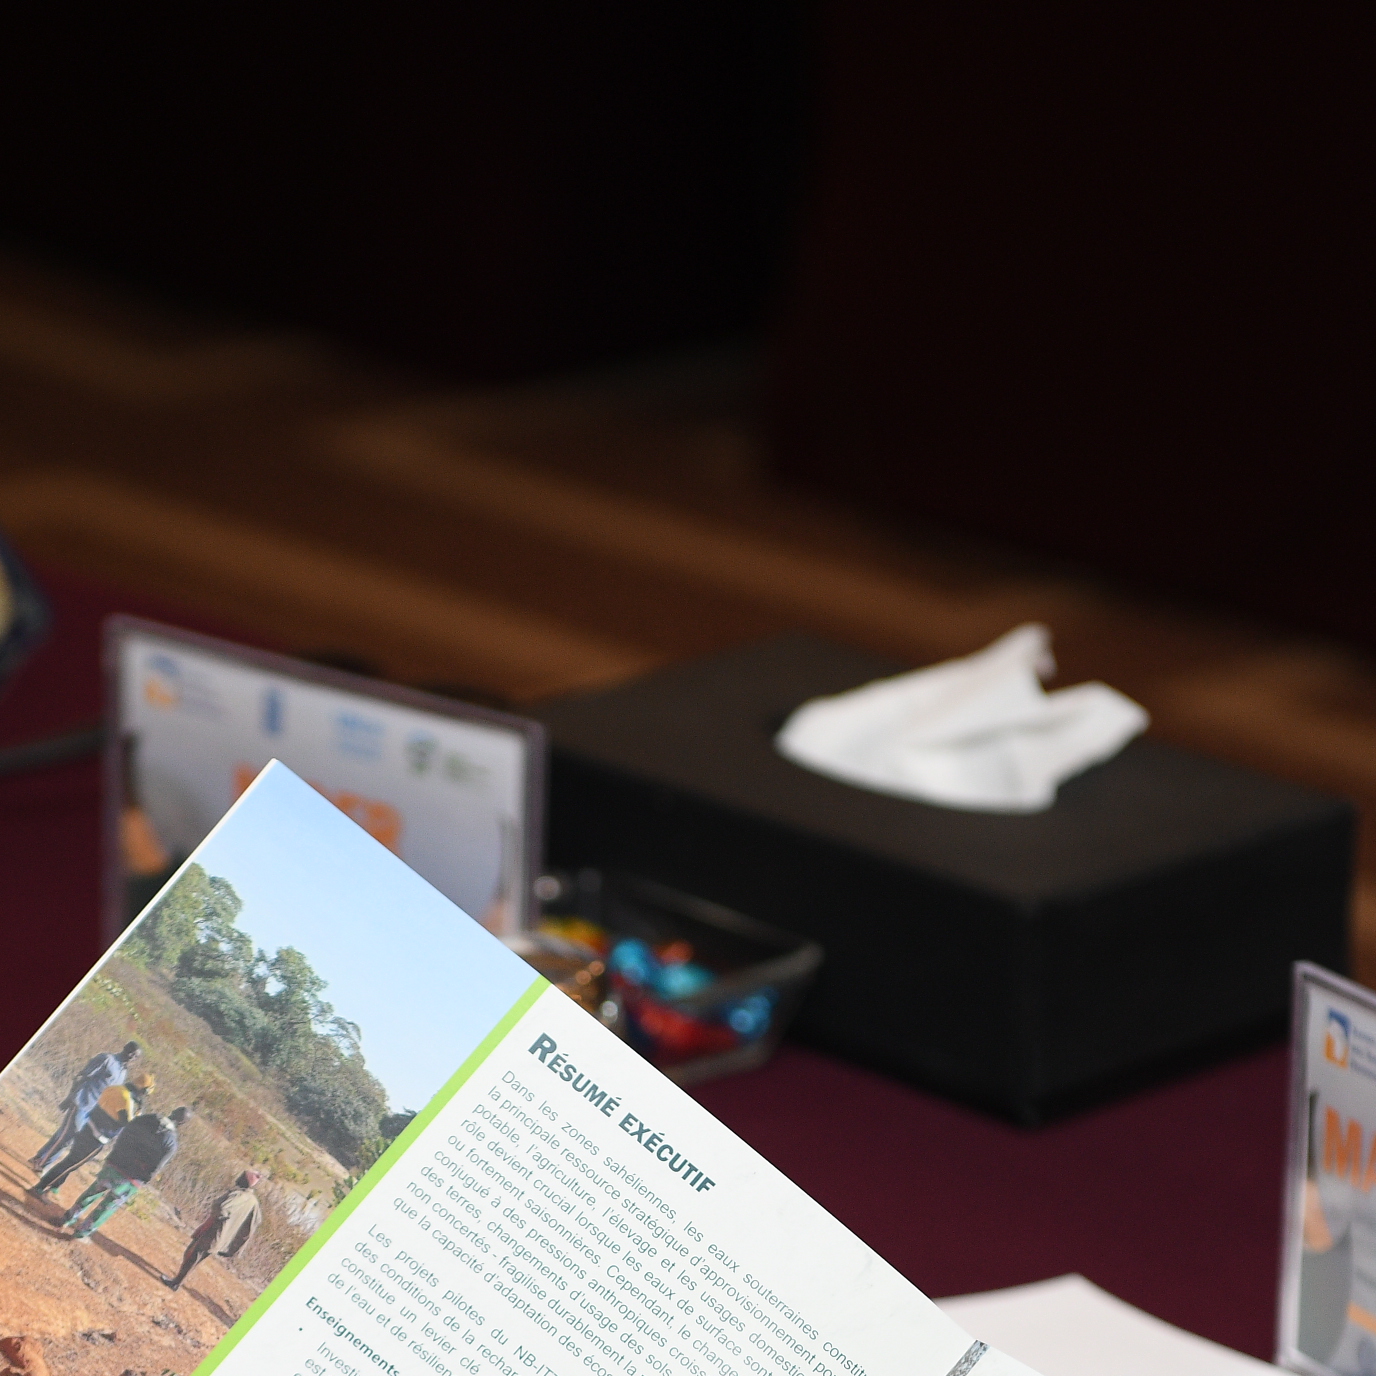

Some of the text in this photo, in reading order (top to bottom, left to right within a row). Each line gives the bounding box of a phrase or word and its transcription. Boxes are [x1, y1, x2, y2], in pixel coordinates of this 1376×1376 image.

[499, 1068, 536, 1103] Dans
[536, 1098, 559, 1123] les
[559, 1120, 601, 1157] zones
[601, 1155, 677, 1225] sahéliennes,
[681, 1219, 705, 1244] les
[706, 1242, 741, 1274] eaux
[741, 1272, 820, 1341] souterraines
[526, 1031, 717, 1194] RÉSUMÉ EXÉCUTIF
[366, 1222, 393, 1249] Les
[393, 1249, 440, 1289] projets
[440, 1288, 486, 1327] pilotes
[489, 1327, 509, 1346] du
[458, 1118, 486, 1143] rôle
[485, 1139, 534, 1182] devient
[531, 1178, 577, 1216] crucial
[573, 1209, 622, 1255] lorsque
[620, 1249, 643, 1273] les
[642, 1270, 677, 1301] eaux
[675, 1298, 695, 1317] de
[694, 1313, 743, 1357] surface
